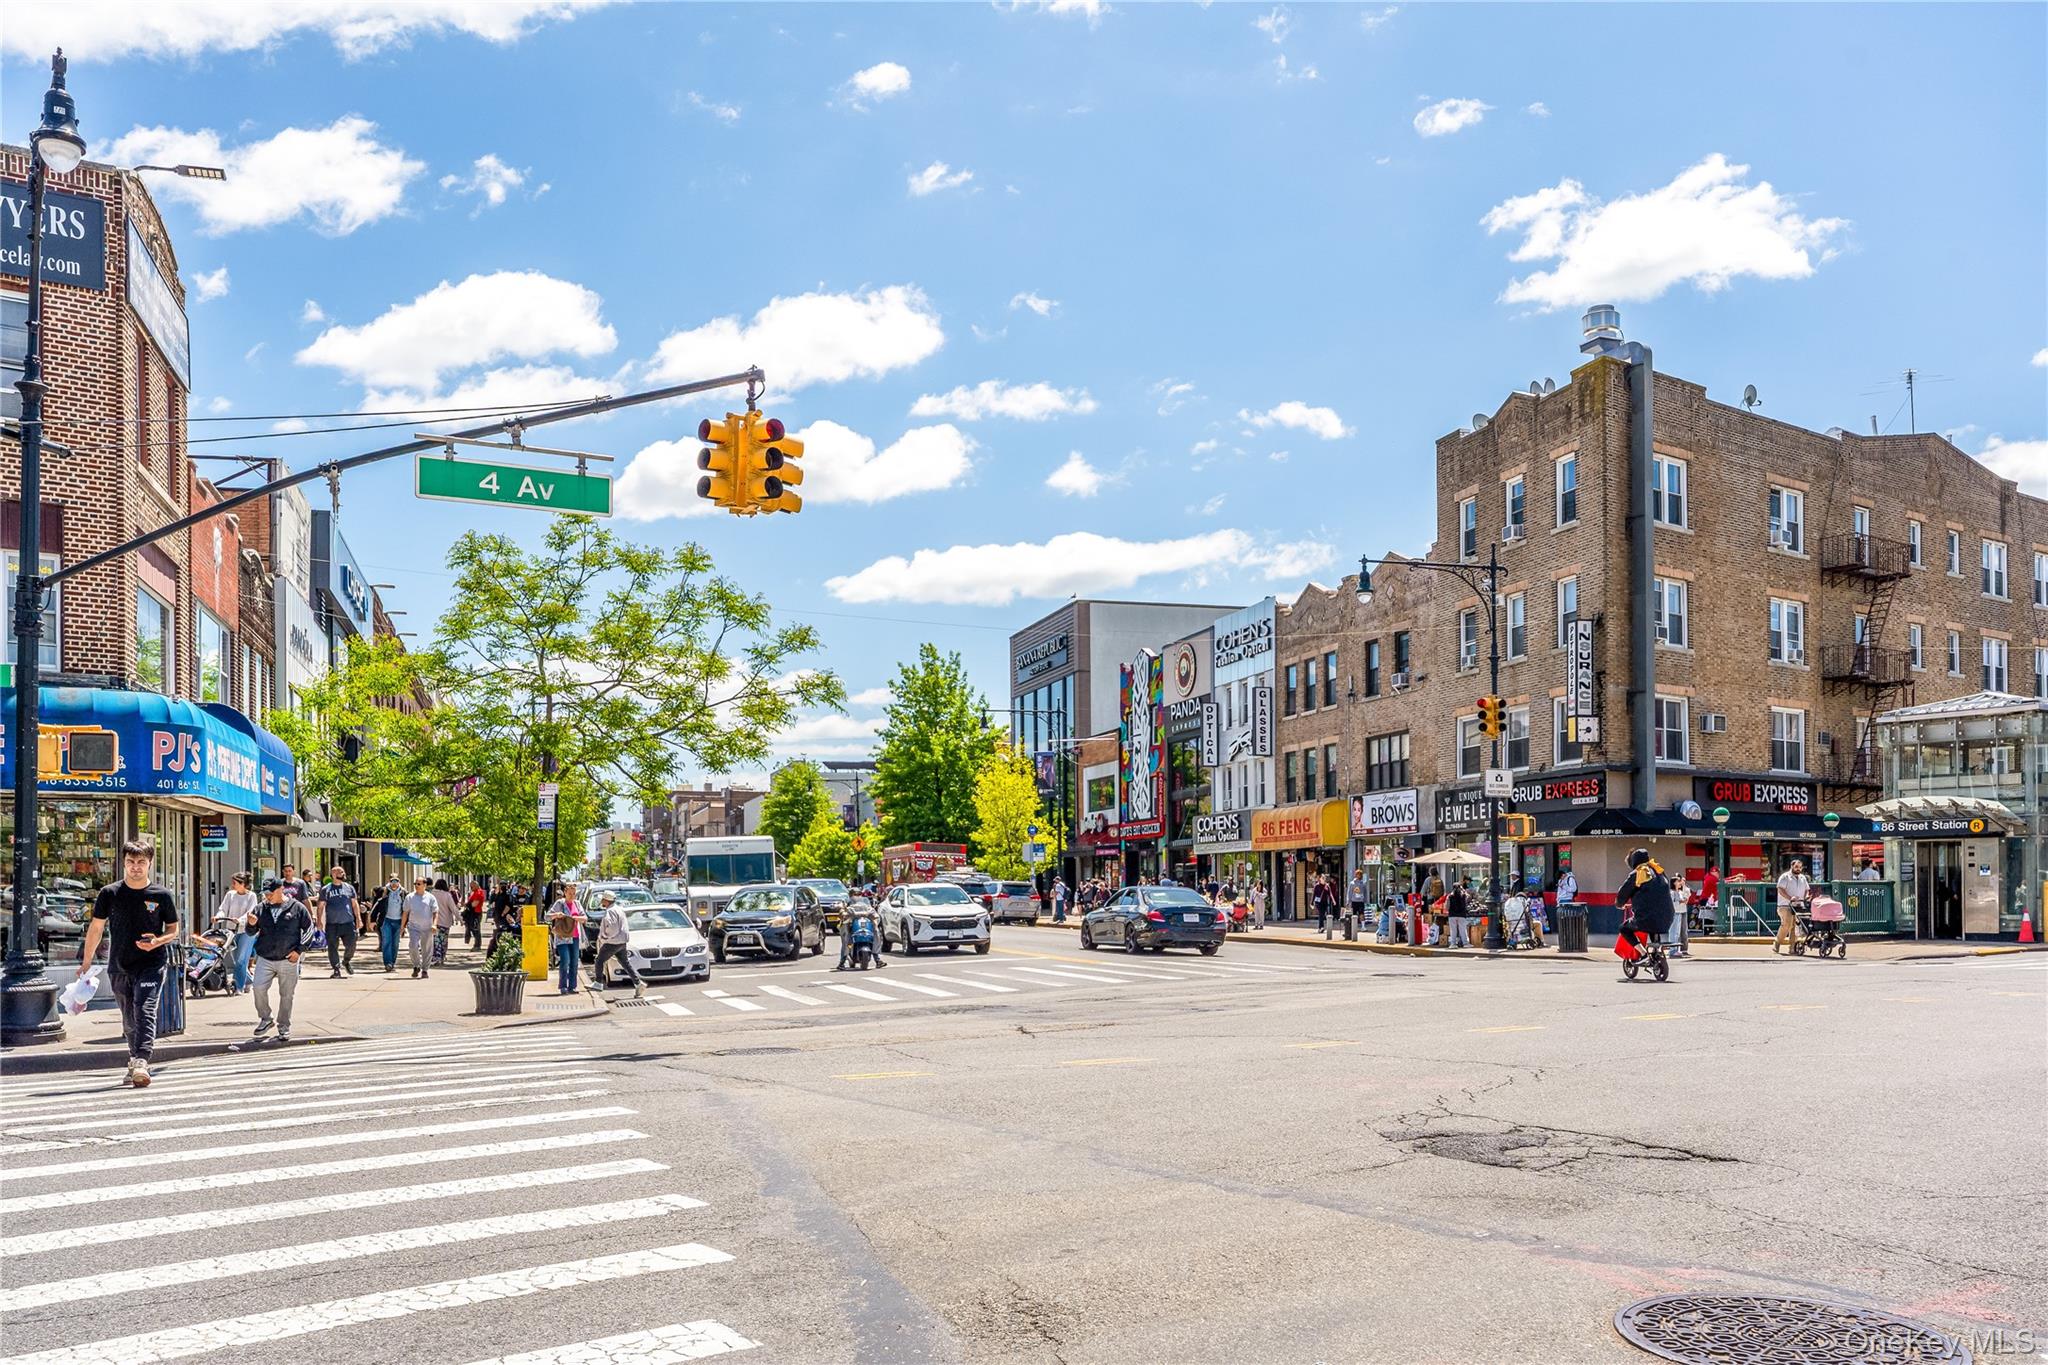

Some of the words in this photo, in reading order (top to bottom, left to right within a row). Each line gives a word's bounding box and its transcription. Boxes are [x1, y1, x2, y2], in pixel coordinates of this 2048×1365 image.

[0, 245, 81, 275] cela.com
[479, 471, 500, 495] 4
[516, 475, 555, 500] Av
[1215, 618, 1272, 653] COHEN'S
[1015, 645, 1041, 671] BANANA
[1038, 636, 1066, 660] REPUBLIC
[1242, 639, 1269, 657] Optical
[1579, 623, 1591, 710] INSURANCE
[1170, 697, 1201, 721] PANDA
[1259, 690, 1267, 752] GLASSES
[1206, 705, 1214, 764] OPTICAL
[157, 780, 173, 789] 401
[1459, 790, 1482, 802] UNIQUE
[1512, 785, 1542, 803] GRUB
[1545, 778, 1599, 799] EXPRESS
[1713, 782, 1750, 801] GRUB
[1754, 784, 1809, 805] EXPRESS
[1197, 813, 1239, 832] COHEN'S
[1371, 803, 1415, 825] BROWS
[1438, 801, 1504, 823] JEWELES
[1197, 832, 1217, 843] Fashion
[1217, 829, 1239, 841] Optical
[1261, 822, 1275, 836] 86
[1279, 819, 1311, 835] FENG
[1881, 822, 1894, 832] 86
[1898, 822, 1929, 831] Street
[1932, 820, 1968, 830] Station
